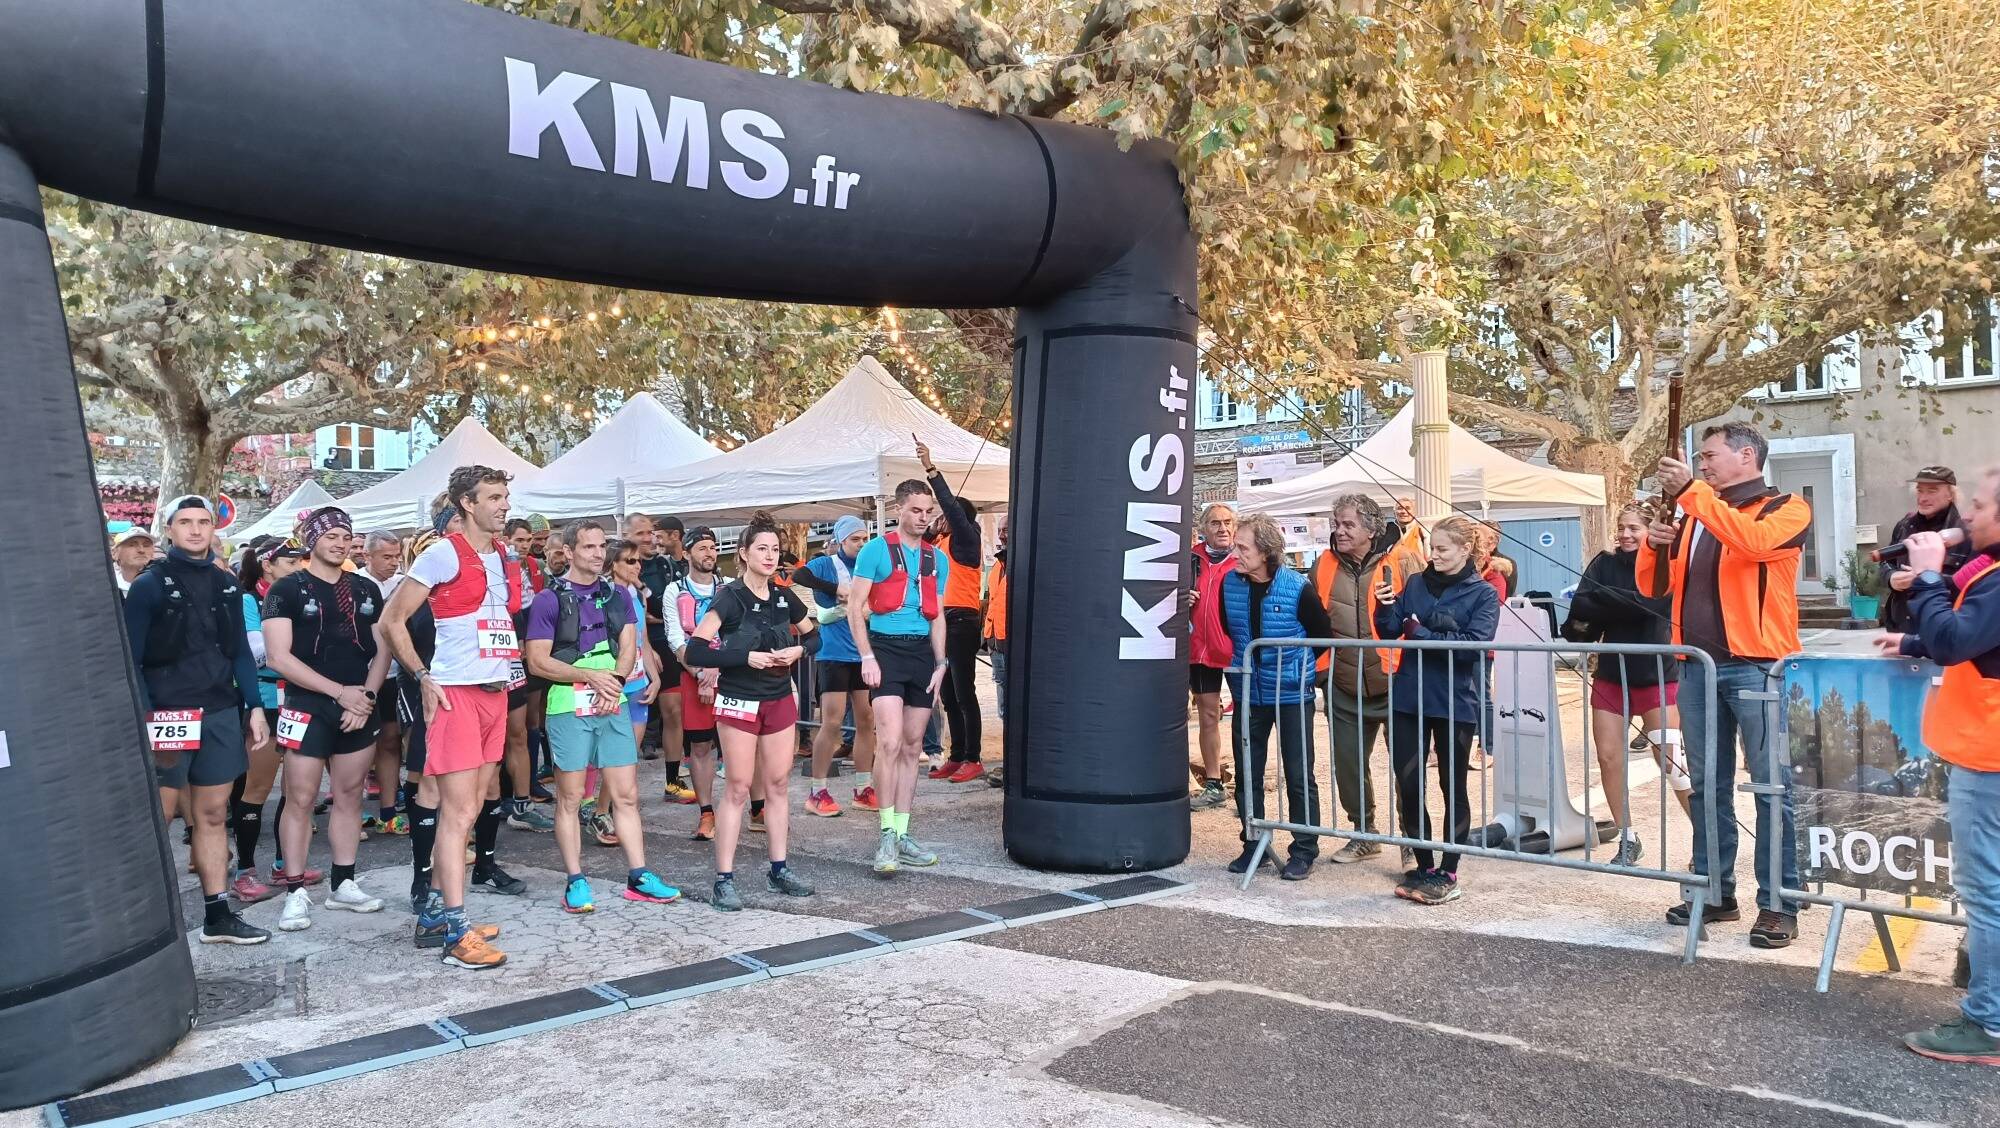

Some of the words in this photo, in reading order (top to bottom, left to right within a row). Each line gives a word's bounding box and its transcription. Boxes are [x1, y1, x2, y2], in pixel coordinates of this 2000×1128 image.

[504, 56, 861, 210] KMS.fr
[1260, 434, 1282, 443] TRAIL
[1283, 433, 1299, 441] DES
[1242, 444, 1272, 454] ROCHES
[1118, 364, 1190, 661] KMS.fr
[489, 633, 512, 646] 790
[153, 710, 193, 722] KMS.fr
[154, 725, 188, 738] 785
